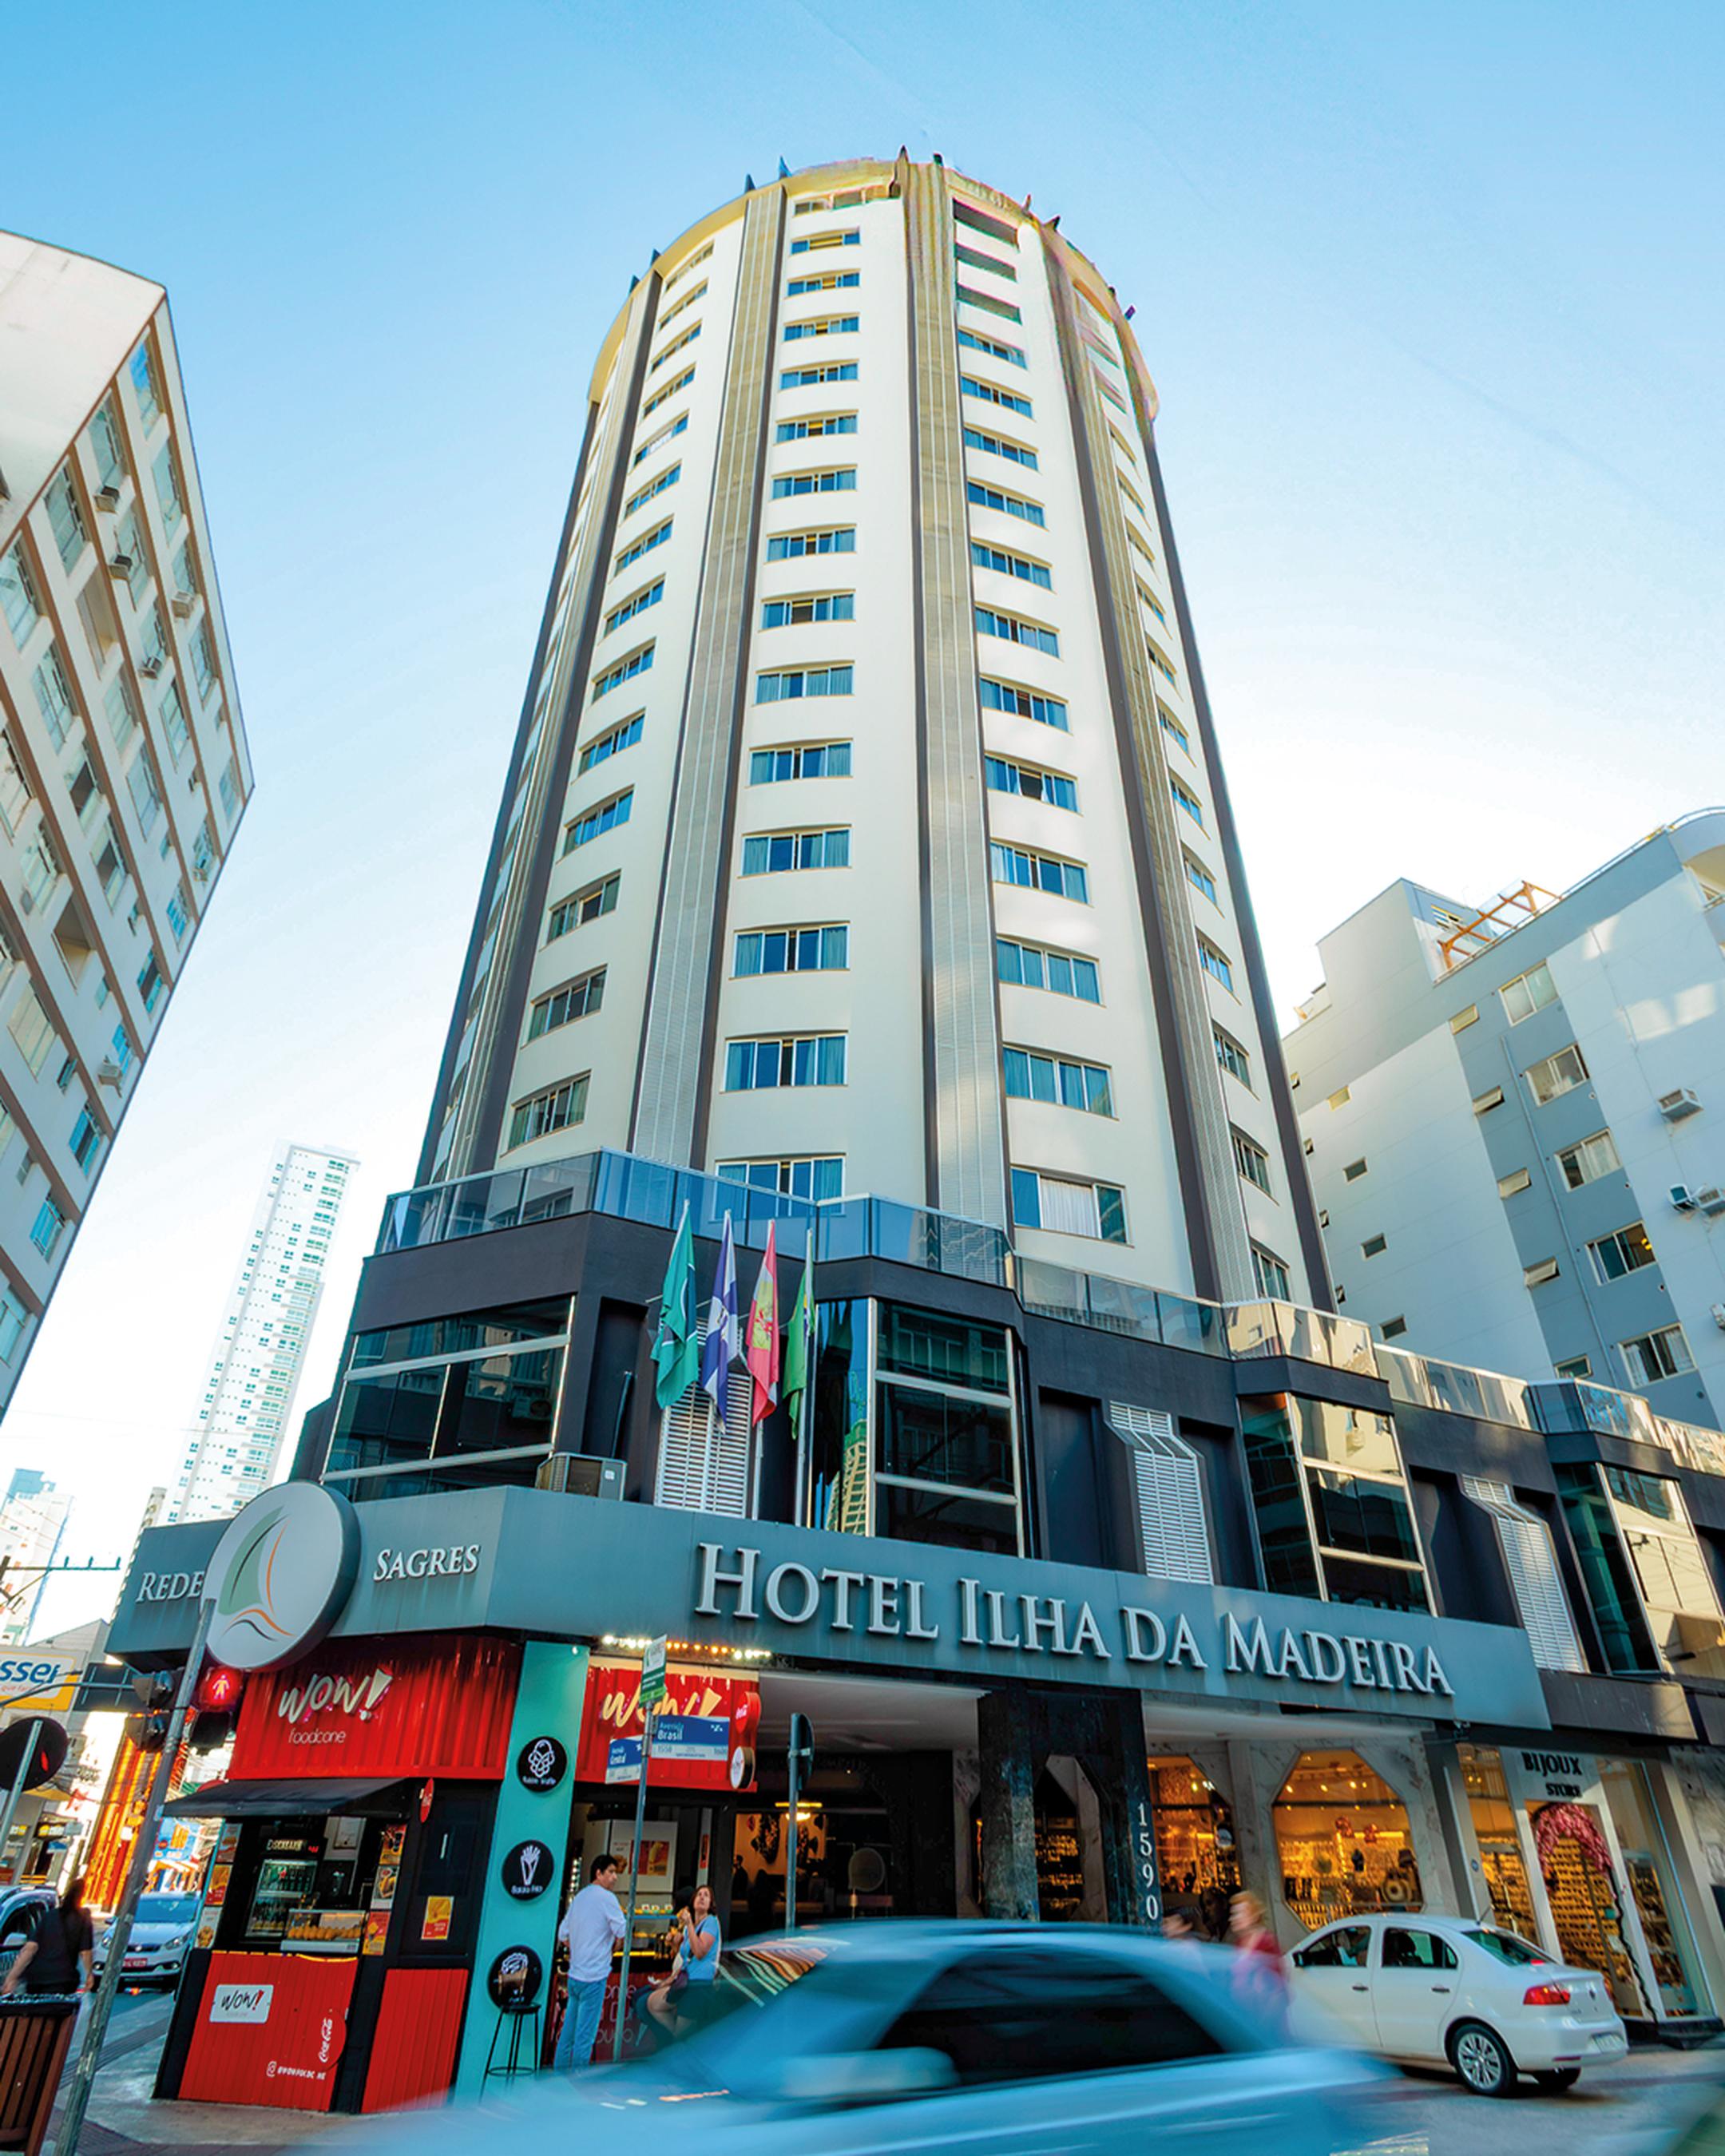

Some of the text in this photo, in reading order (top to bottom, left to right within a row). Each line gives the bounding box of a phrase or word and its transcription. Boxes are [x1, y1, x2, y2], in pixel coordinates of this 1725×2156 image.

[373, 1544, 481, 1582] SAGRES
[135, 1571, 205, 1603] REDE
[694, 1542, 1456, 1696] HOTEL ILHA DA MADEIRA
[278, 1668, 394, 1724] WOW!
[288, 1728, 347, 1744] foodcone
[657, 1729, 683, 1741] Brasil
[1521, 1750, 1583, 1777] BIJOUX
[1545, 1782, 1582, 1798] STORE
[1137, 1802, 1159, 1920] 1590
[221, 1989, 265, 2011] WOW!
